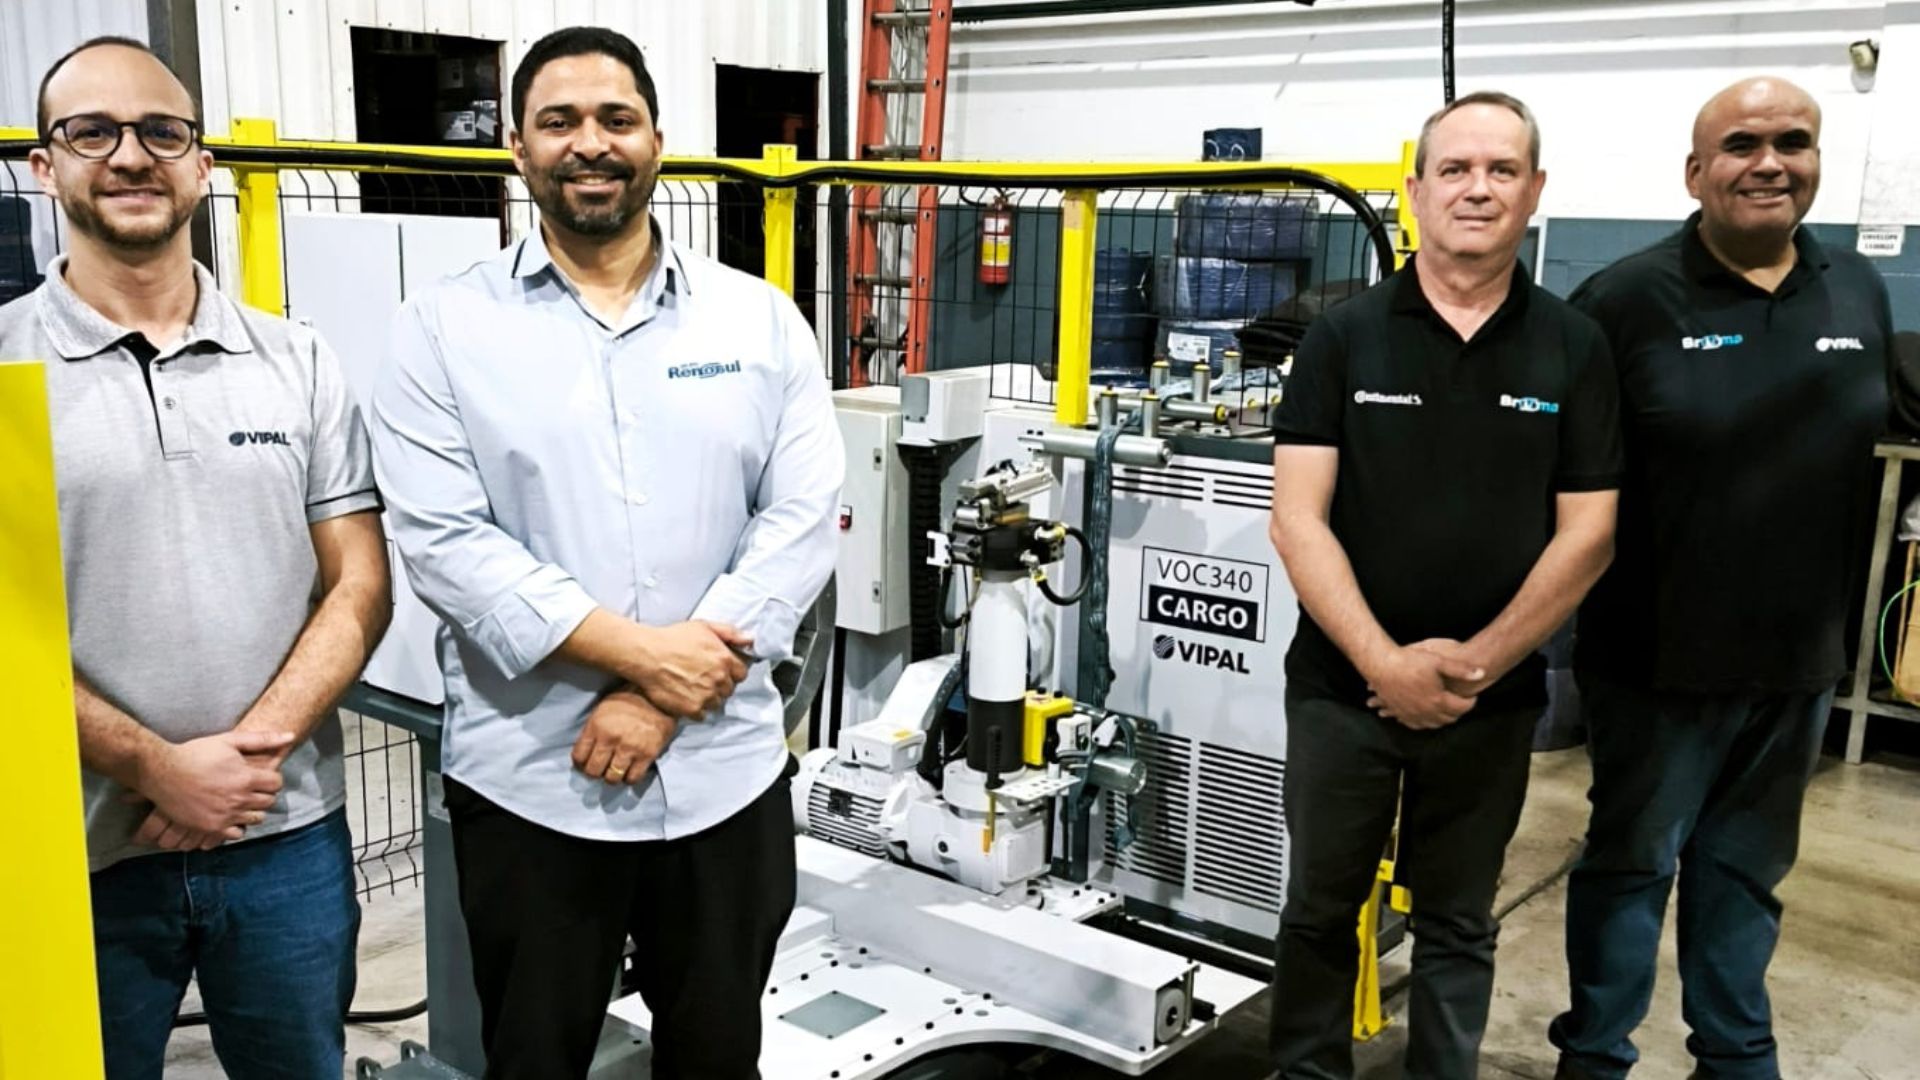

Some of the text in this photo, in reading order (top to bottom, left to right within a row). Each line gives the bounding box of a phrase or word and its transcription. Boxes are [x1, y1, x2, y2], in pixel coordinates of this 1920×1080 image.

[246, 431, 291, 446] VIPAL
[1157, 557, 1253, 593] VOC340
[1157, 594, 1249, 629] CARGO
[1177, 640, 1250, 675] VIPAL
